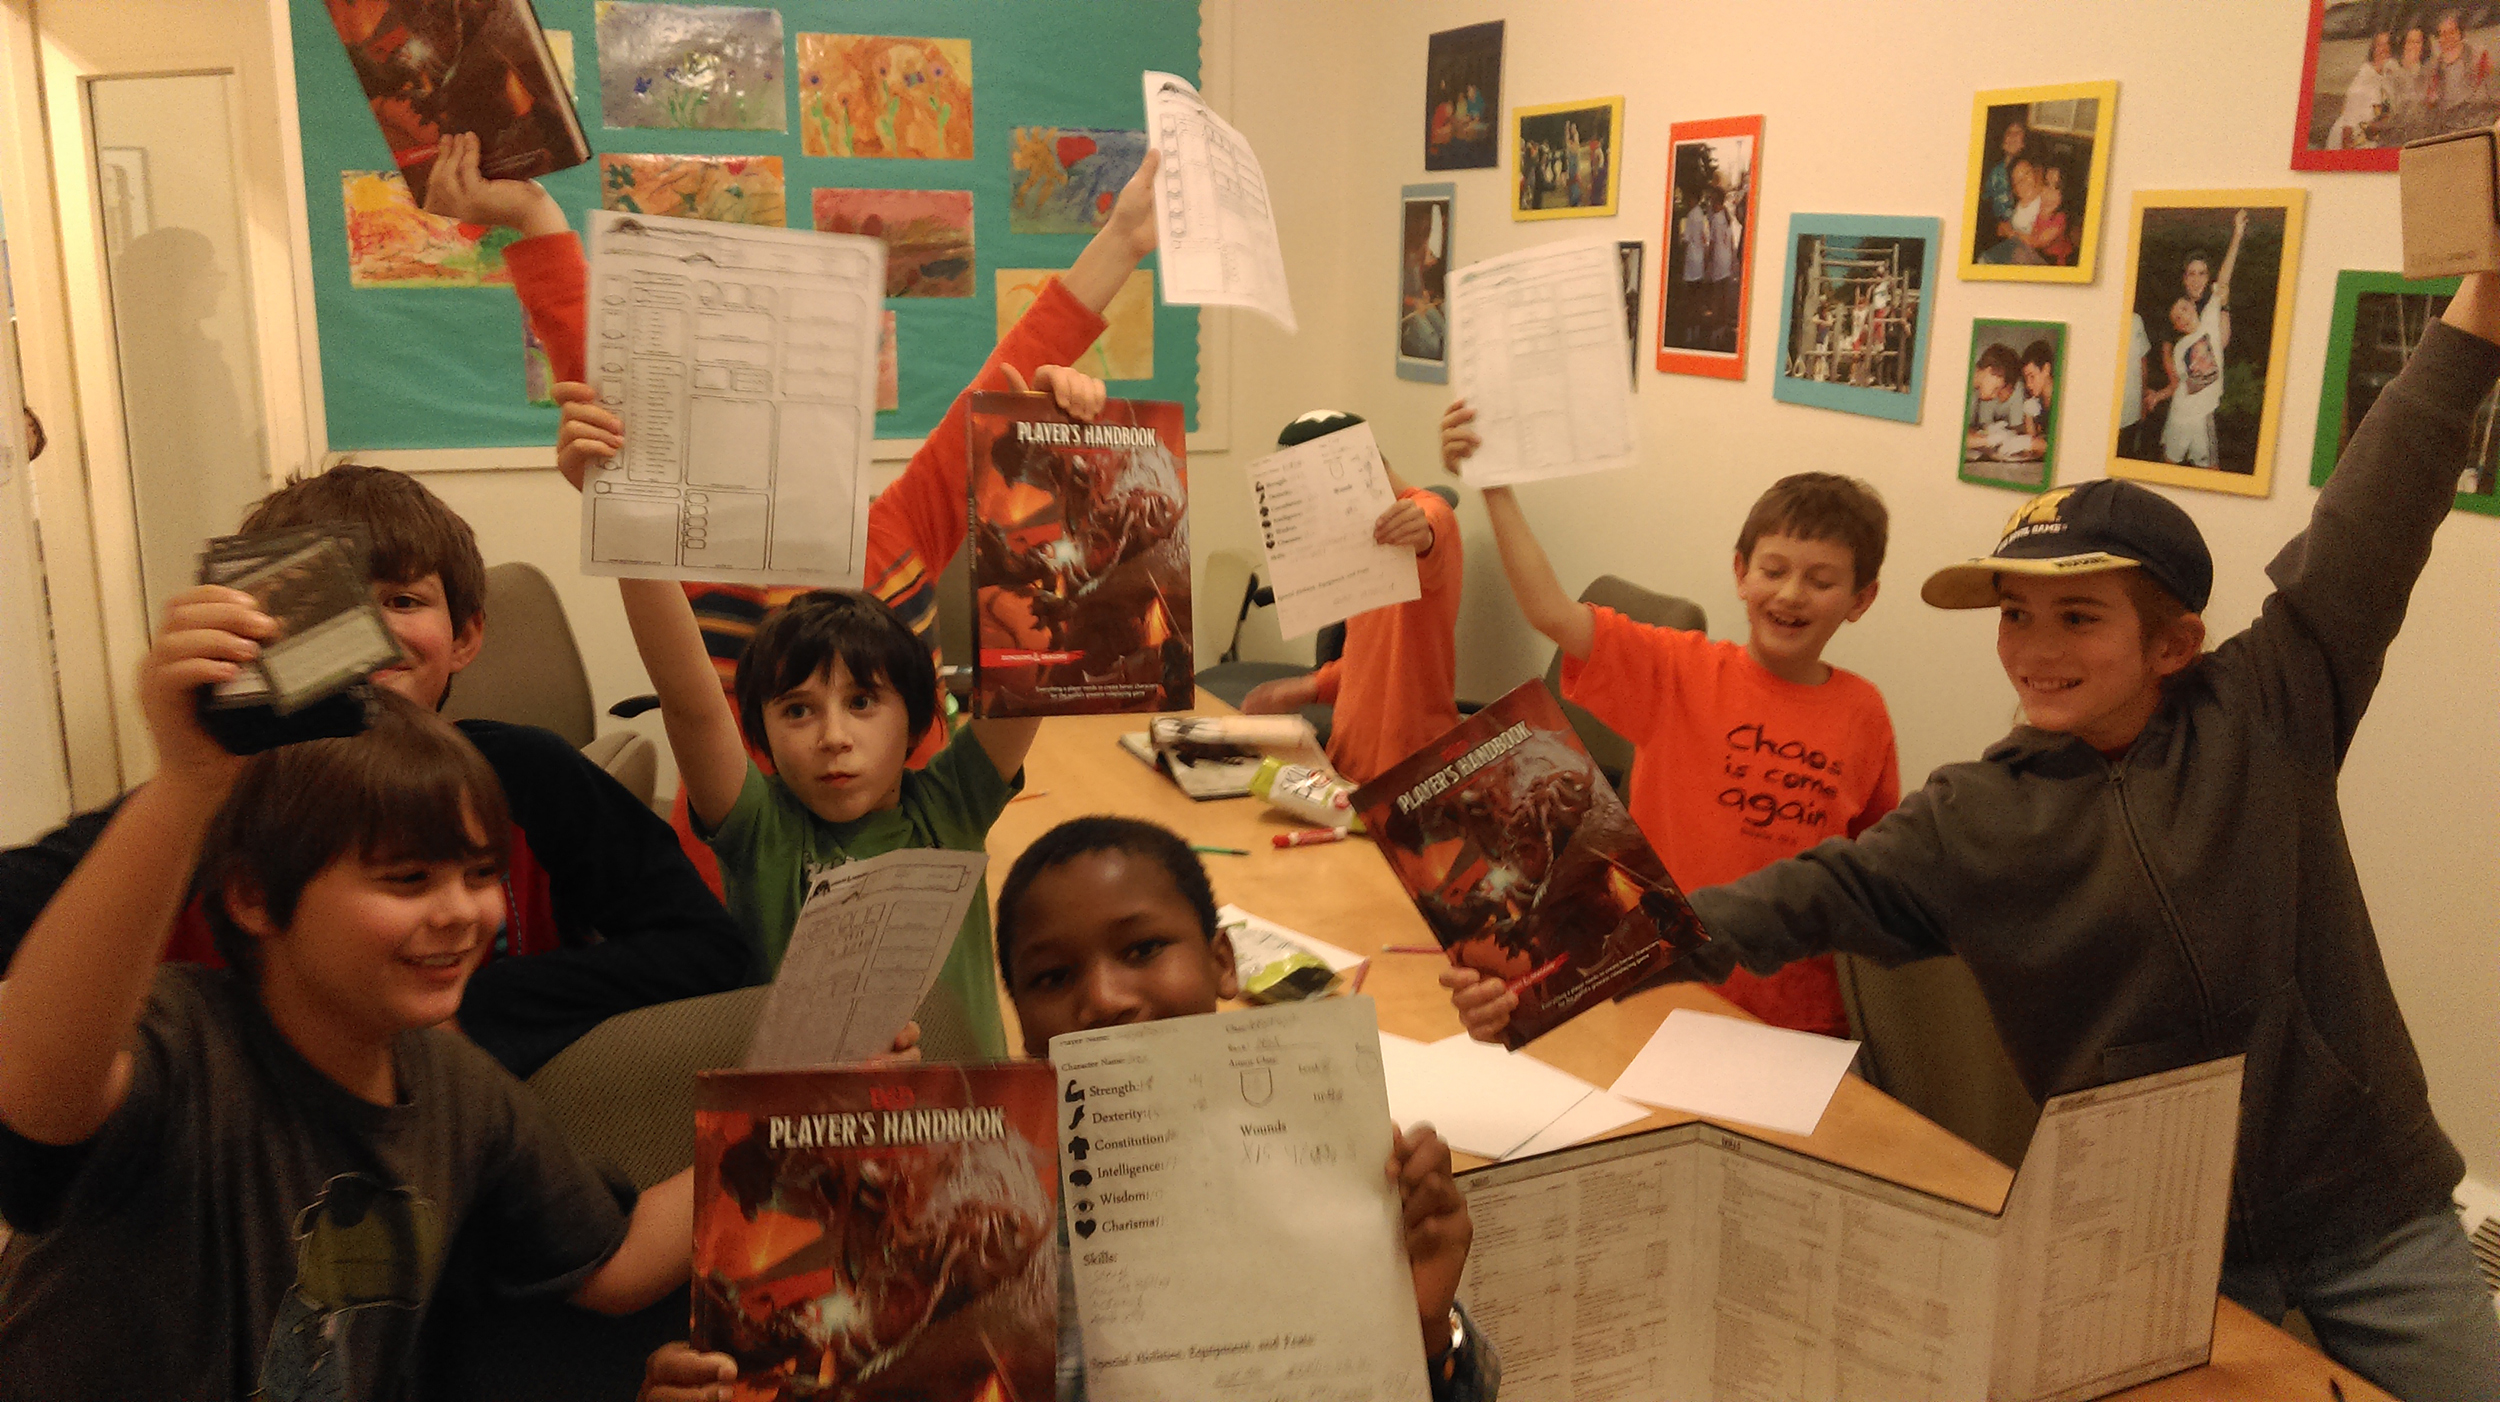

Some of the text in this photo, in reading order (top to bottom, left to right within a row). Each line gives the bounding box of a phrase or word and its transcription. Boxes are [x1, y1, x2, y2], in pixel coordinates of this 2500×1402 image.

[1016, 421, 1157, 448] PLAYER'S HANDBOOK
[1396, 764, 1460, 815] PLAYER'S
[1456, 720, 1533, 777] HANDBOOK
[1725, 723, 1843, 776] Chaos
[1725, 754, 1838, 798] is come
[1717, 787, 1827, 827] again
[769, 1106, 1007, 1148] PLAYER'S HANDBOOK
[1240, 1119, 1287, 1137] Wounds
